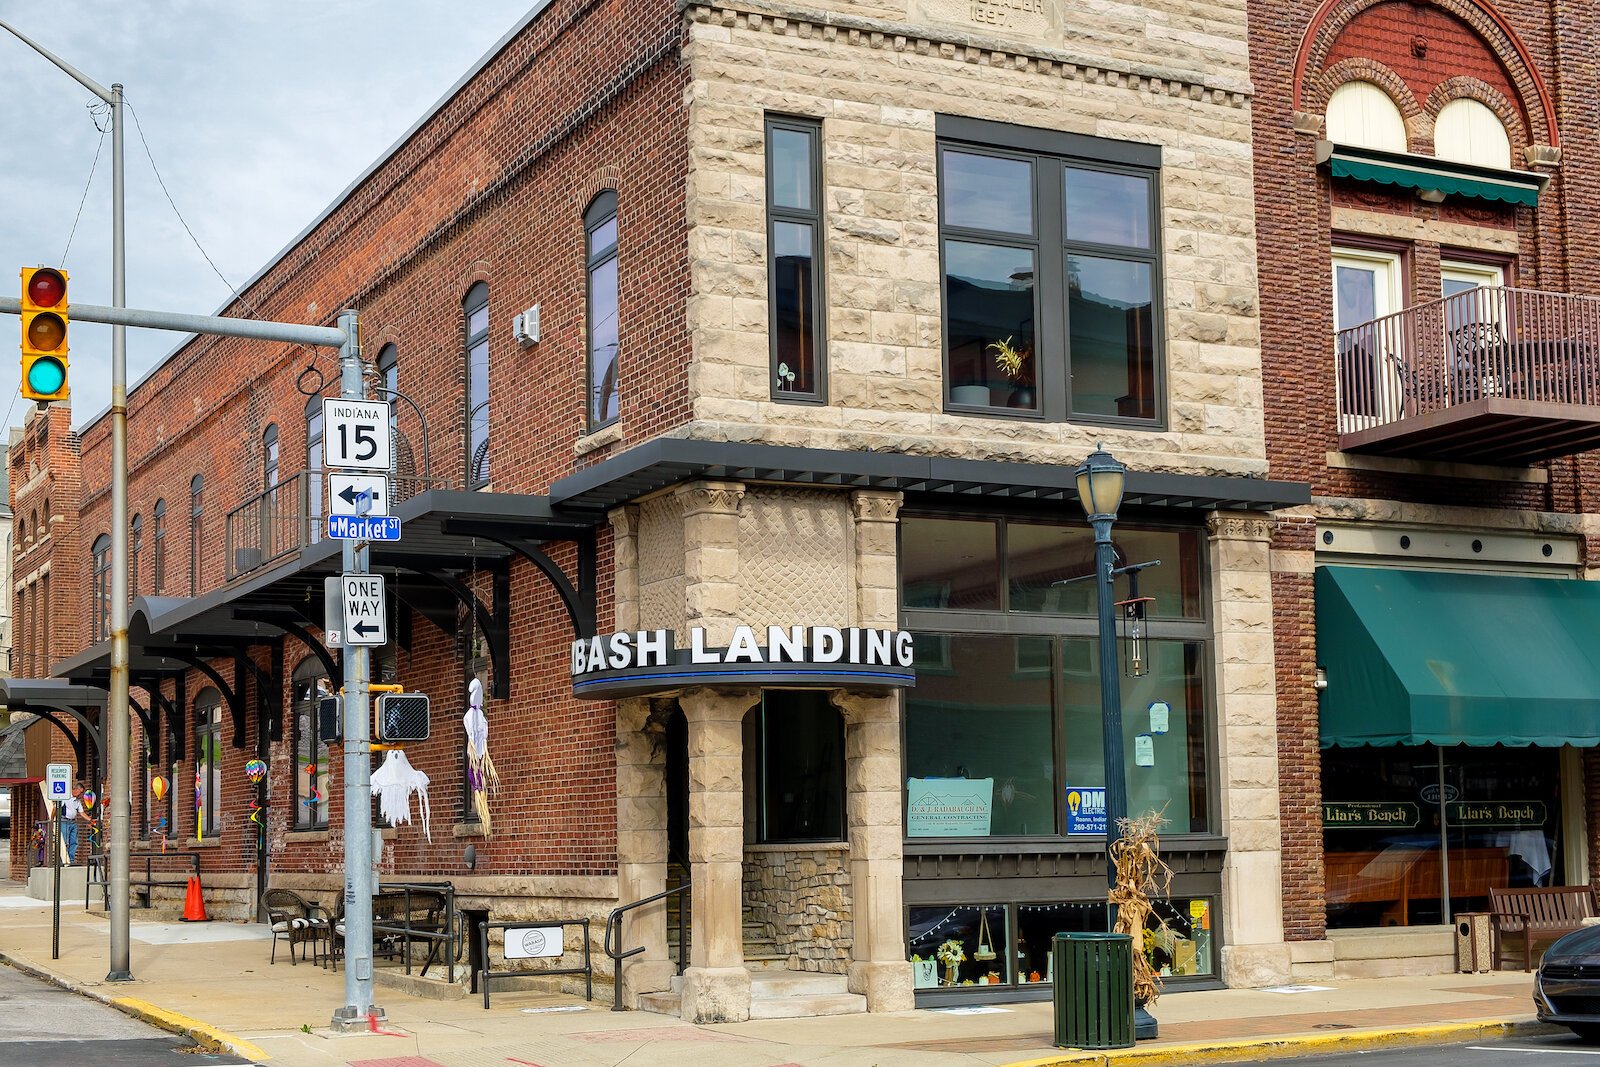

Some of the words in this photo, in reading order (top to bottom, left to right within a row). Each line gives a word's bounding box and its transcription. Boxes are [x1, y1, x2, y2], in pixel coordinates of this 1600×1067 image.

[334, 407, 380, 420] INDIANA
[337, 423, 377, 461] 15
[337, 517, 388, 539] Market
[389, 519, 399, 529] ST
[348, 581, 379, 597] ONE
[348, 600, 380, 617] WAY
[330, 632, 338, 643] 2
[691, 624, 914, 667] LANDING
[1326, 807, 1362, 822] Liar's
[1367, 807, 1408, 823] Bench
[1458, 806, 1493, 820] Liar's
[1498, 805, 1535, 822] Bench
